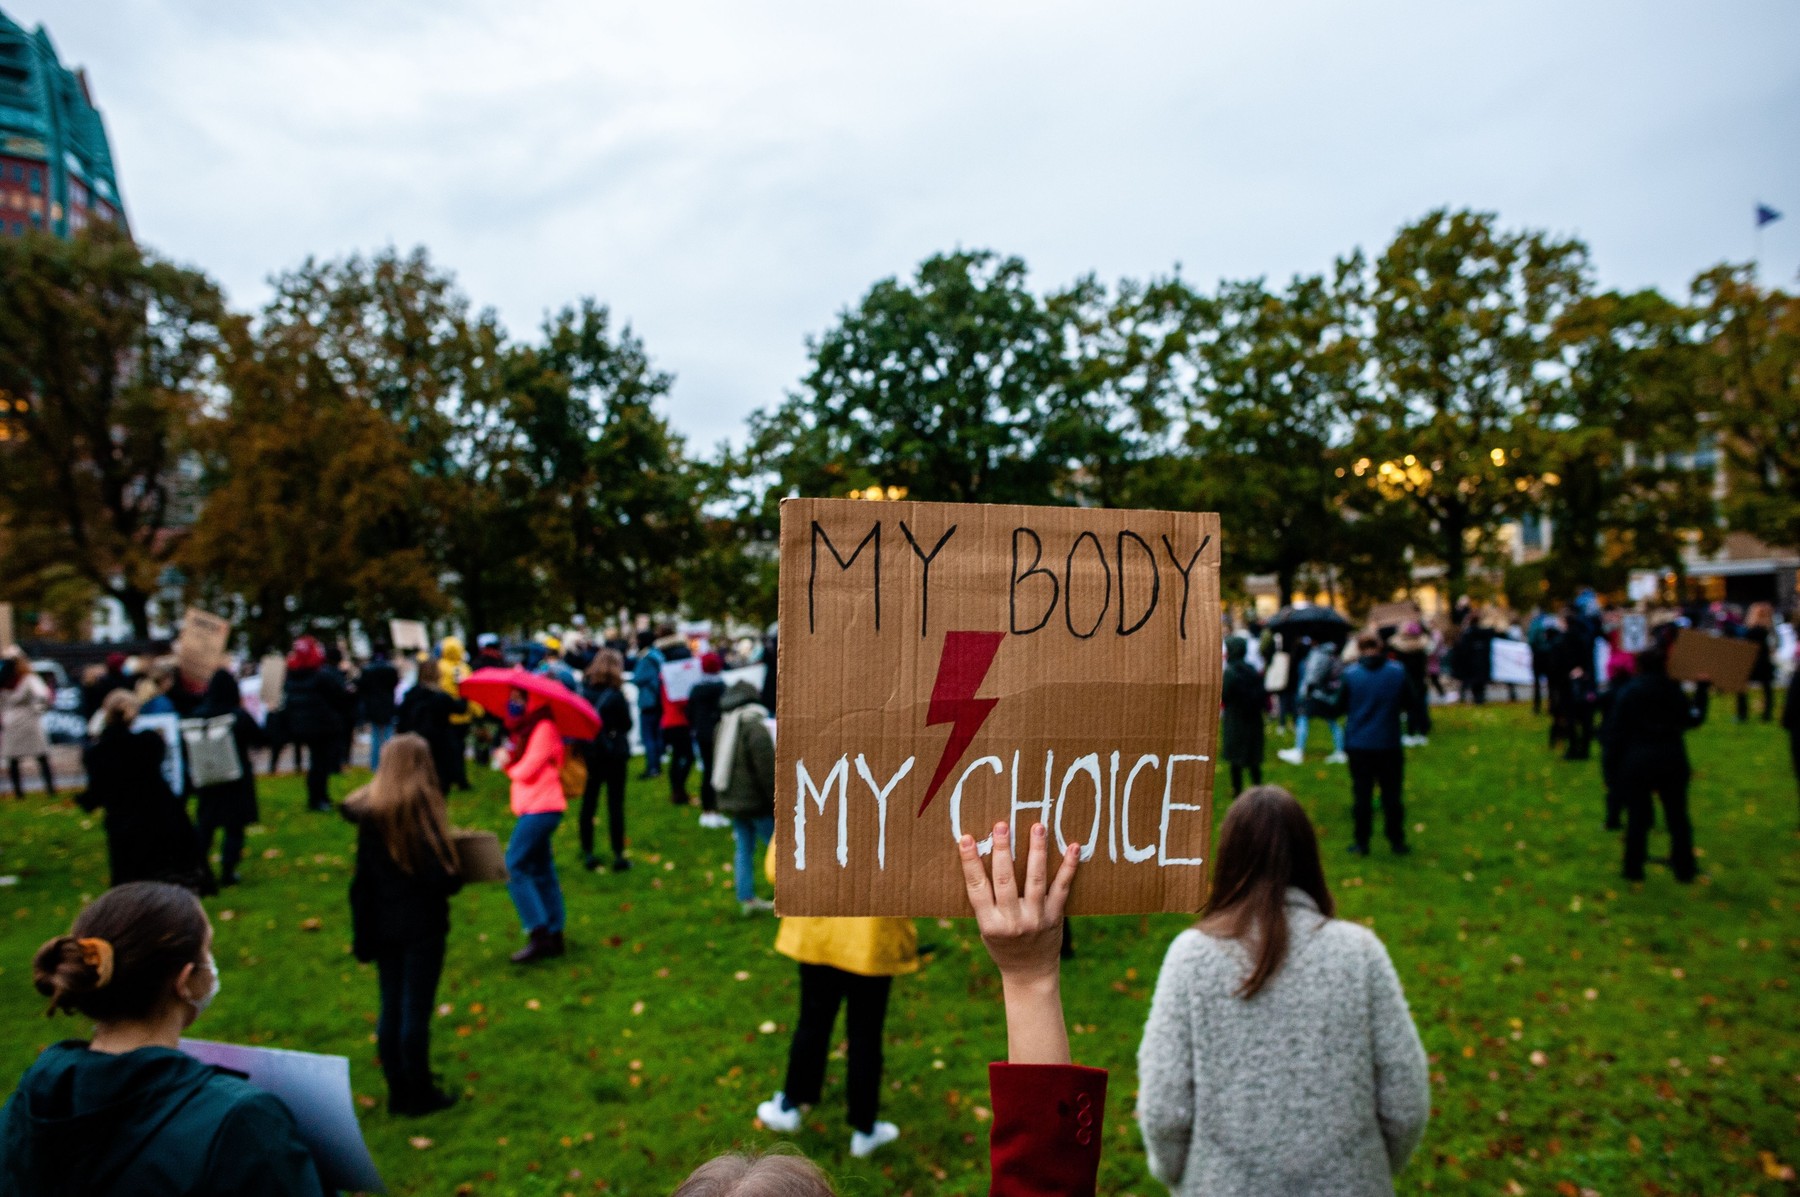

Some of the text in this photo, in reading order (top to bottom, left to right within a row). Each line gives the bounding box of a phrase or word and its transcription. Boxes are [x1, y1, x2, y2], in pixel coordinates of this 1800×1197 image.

[809, 519, 1211, 640] MY BODY
[793, 748, 1210, 871] MY CHOICE
